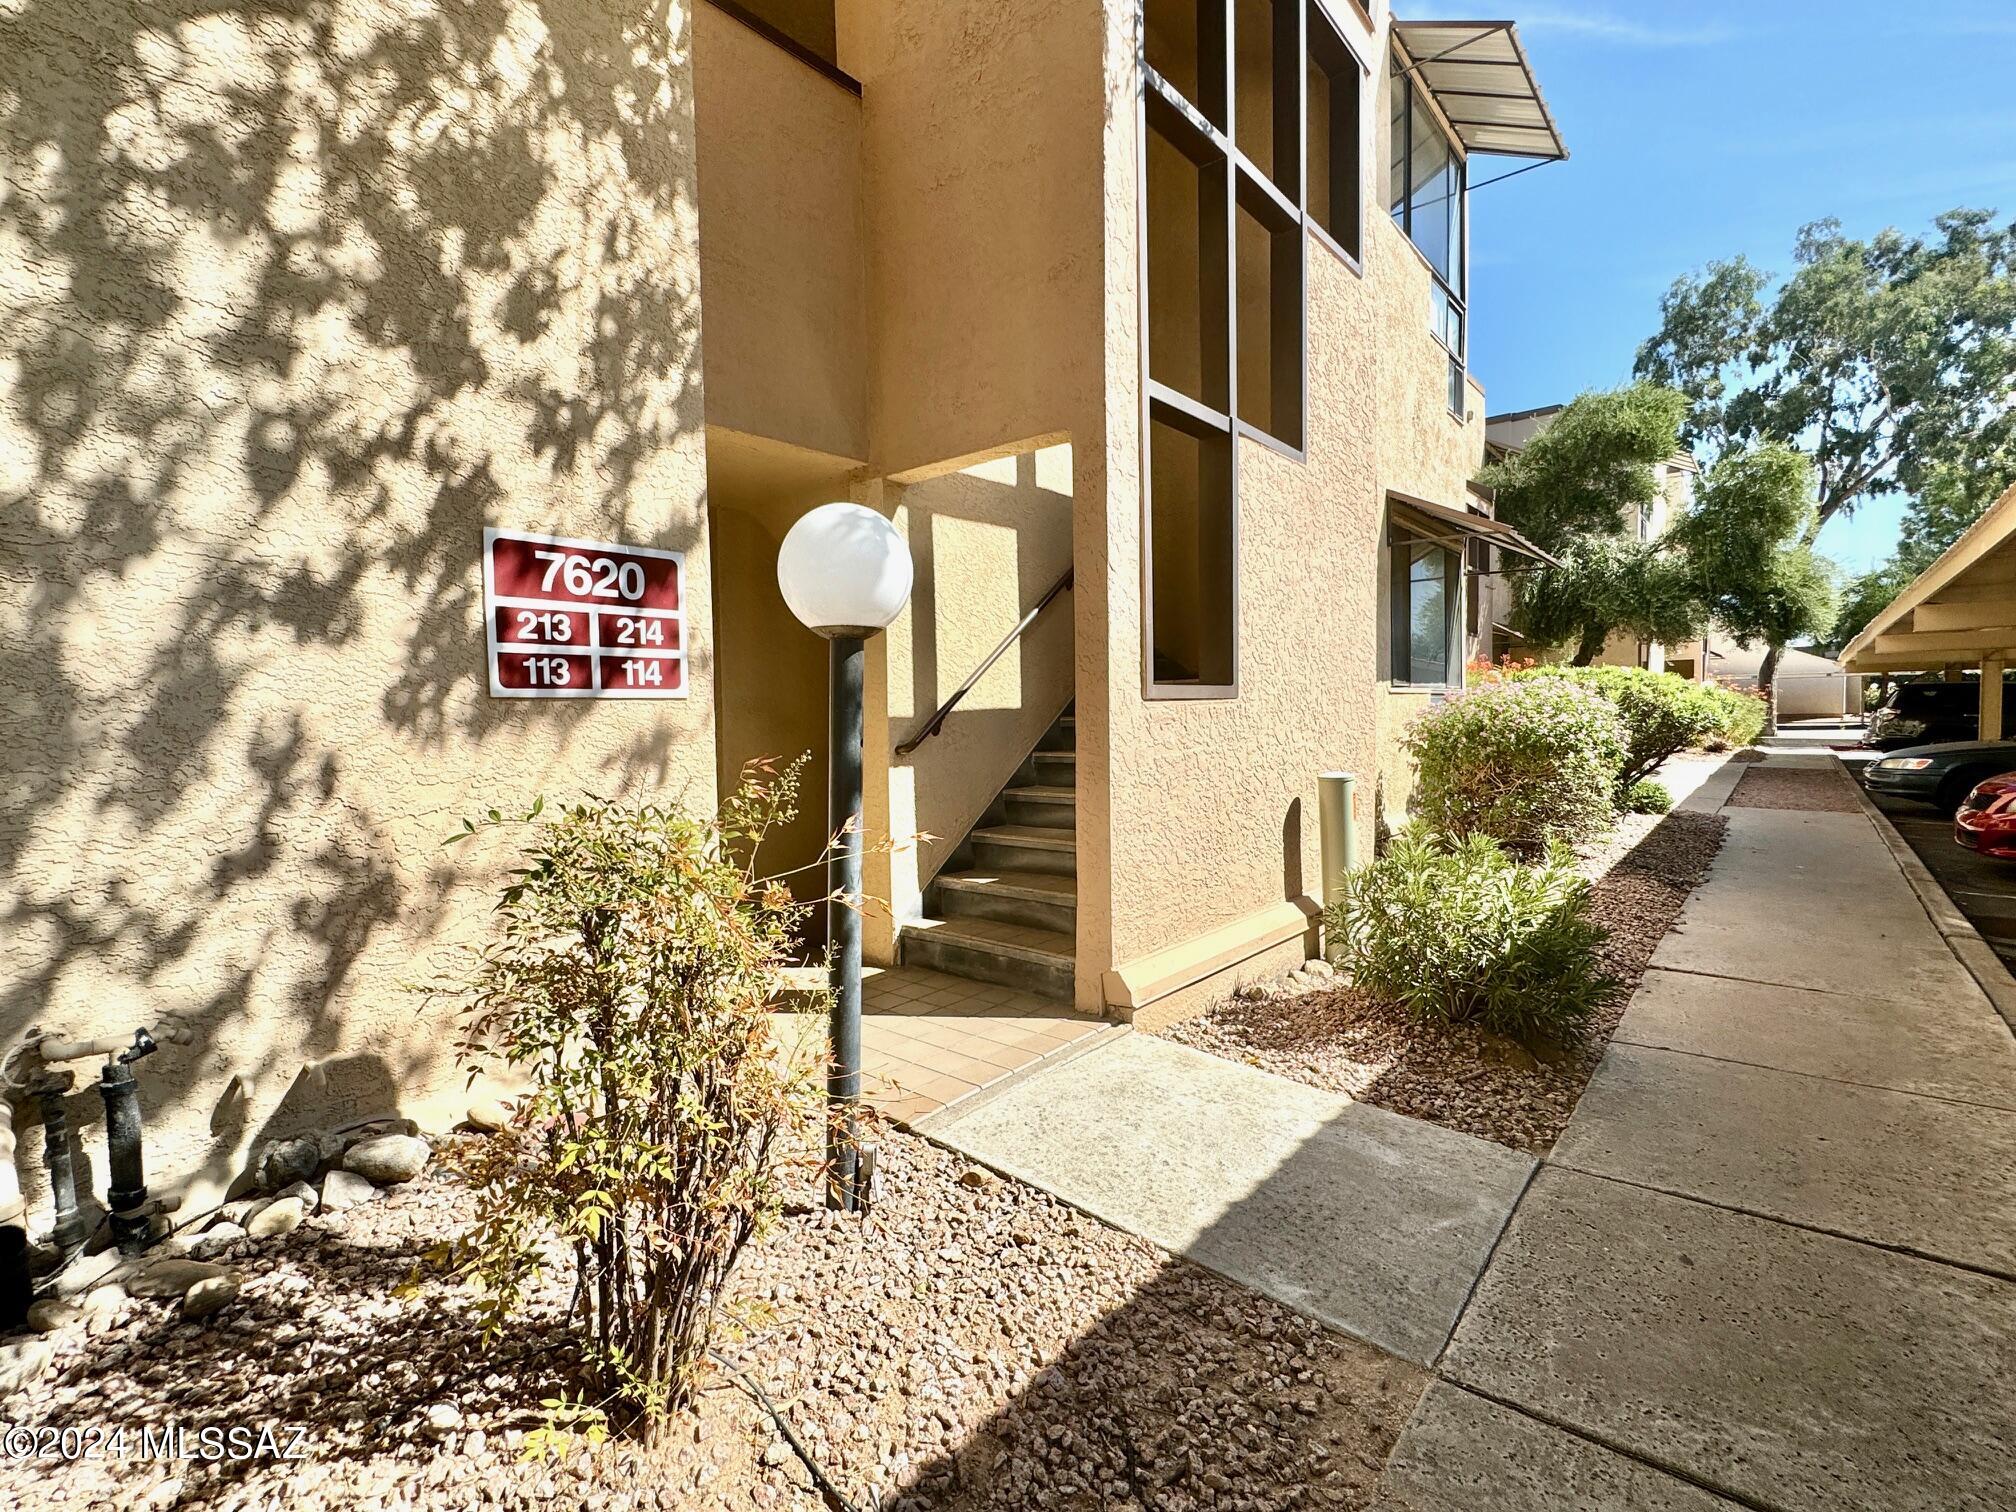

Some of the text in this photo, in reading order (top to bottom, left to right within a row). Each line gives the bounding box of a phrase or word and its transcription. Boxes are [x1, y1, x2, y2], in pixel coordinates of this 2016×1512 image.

[534, 550, 646, 601] 7620
[516, 611, 572, 642] 213
[616, 617, 664, 646] 214
[522, 657, 571, 686] 113
[621, 660, 663, 686] 114
